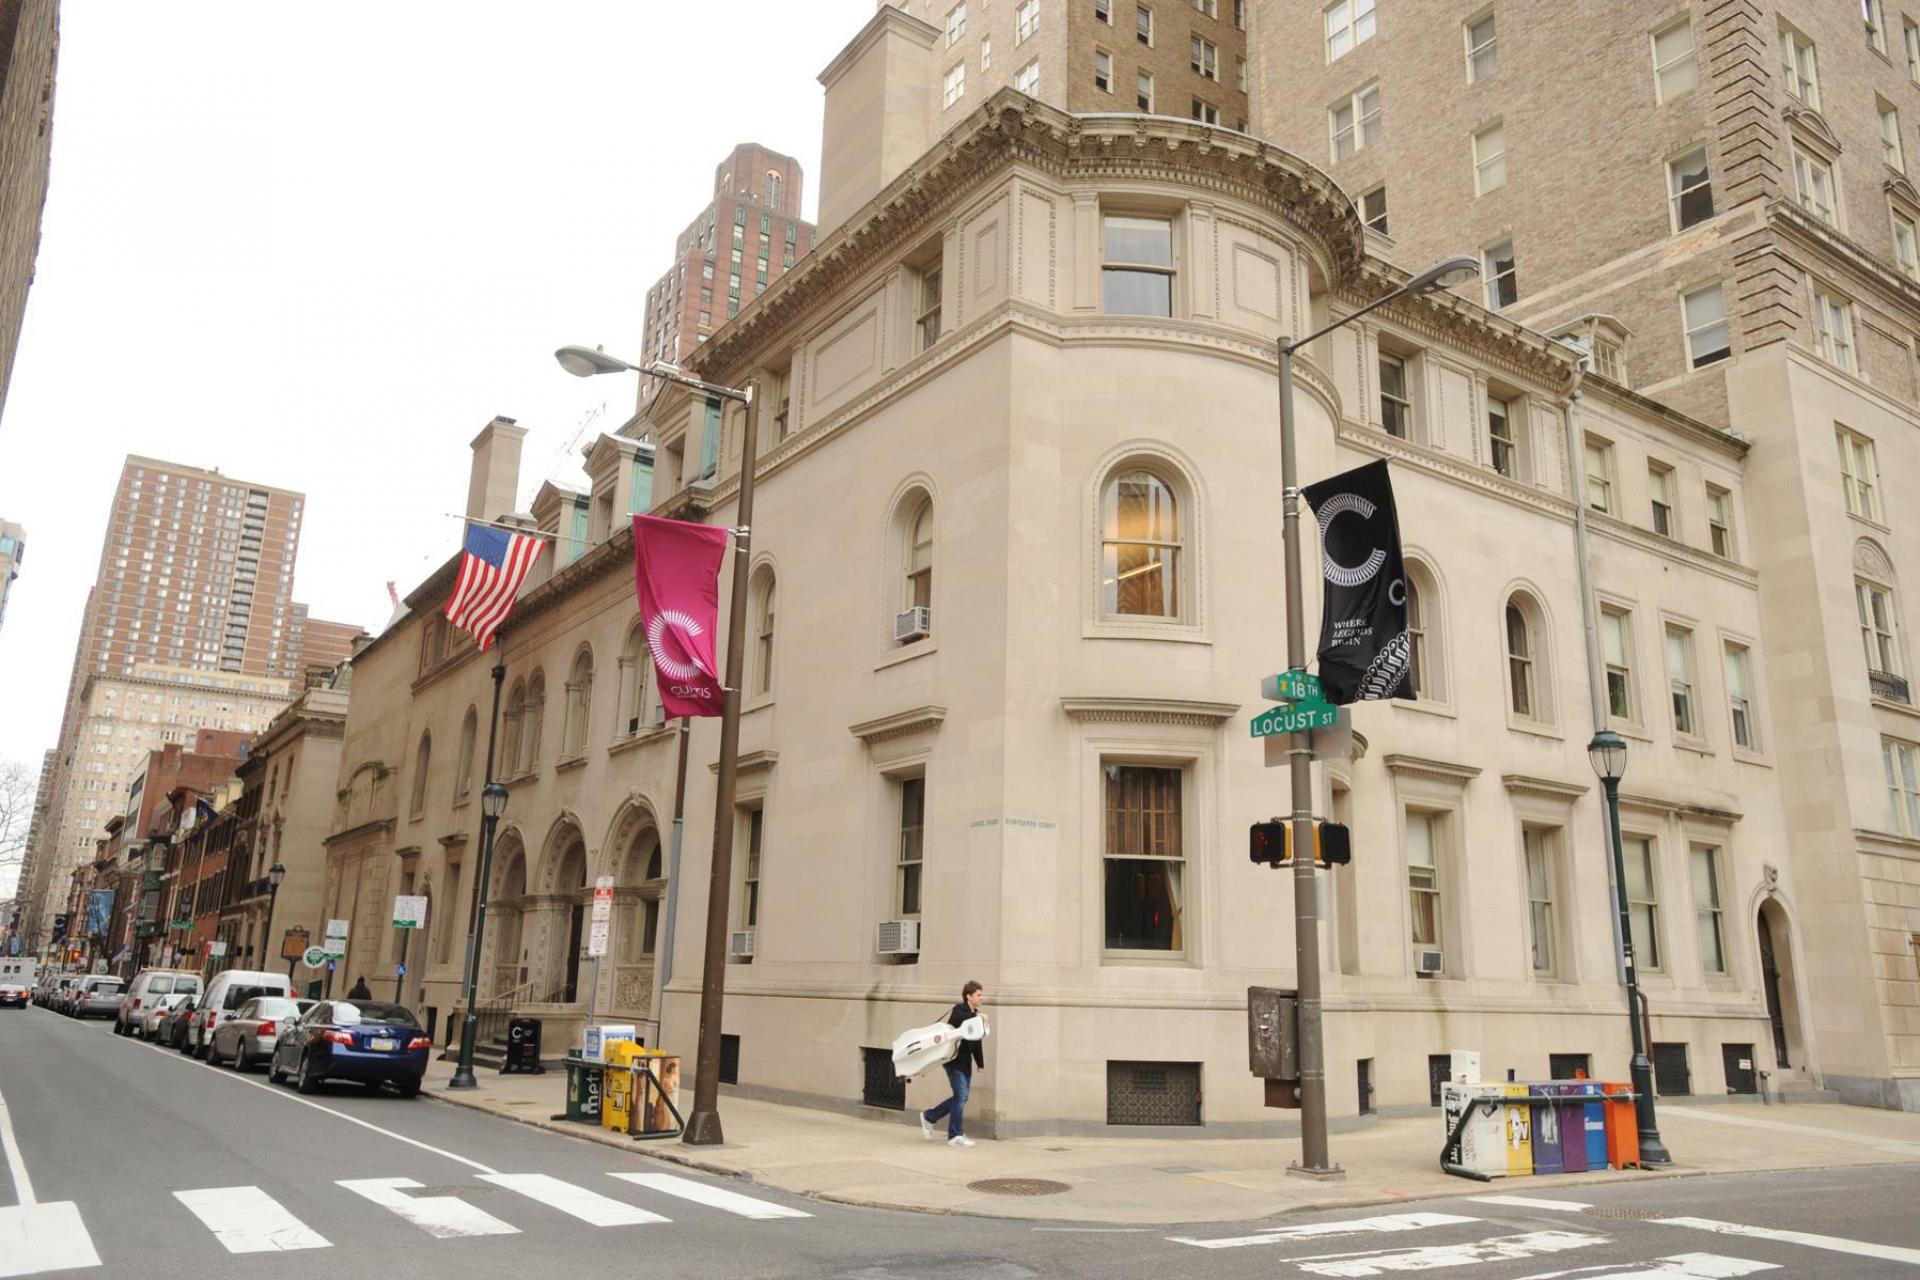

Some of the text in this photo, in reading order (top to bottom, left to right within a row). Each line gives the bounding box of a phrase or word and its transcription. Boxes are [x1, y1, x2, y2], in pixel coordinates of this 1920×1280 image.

[1334, 619, 1367, 629] WHERE
[1332, 627, 1374, 638] LEGEDS
[1291, 681, 1318, 698] 18 TH
[1253, 710, 1333, 737] LOCUST ST
